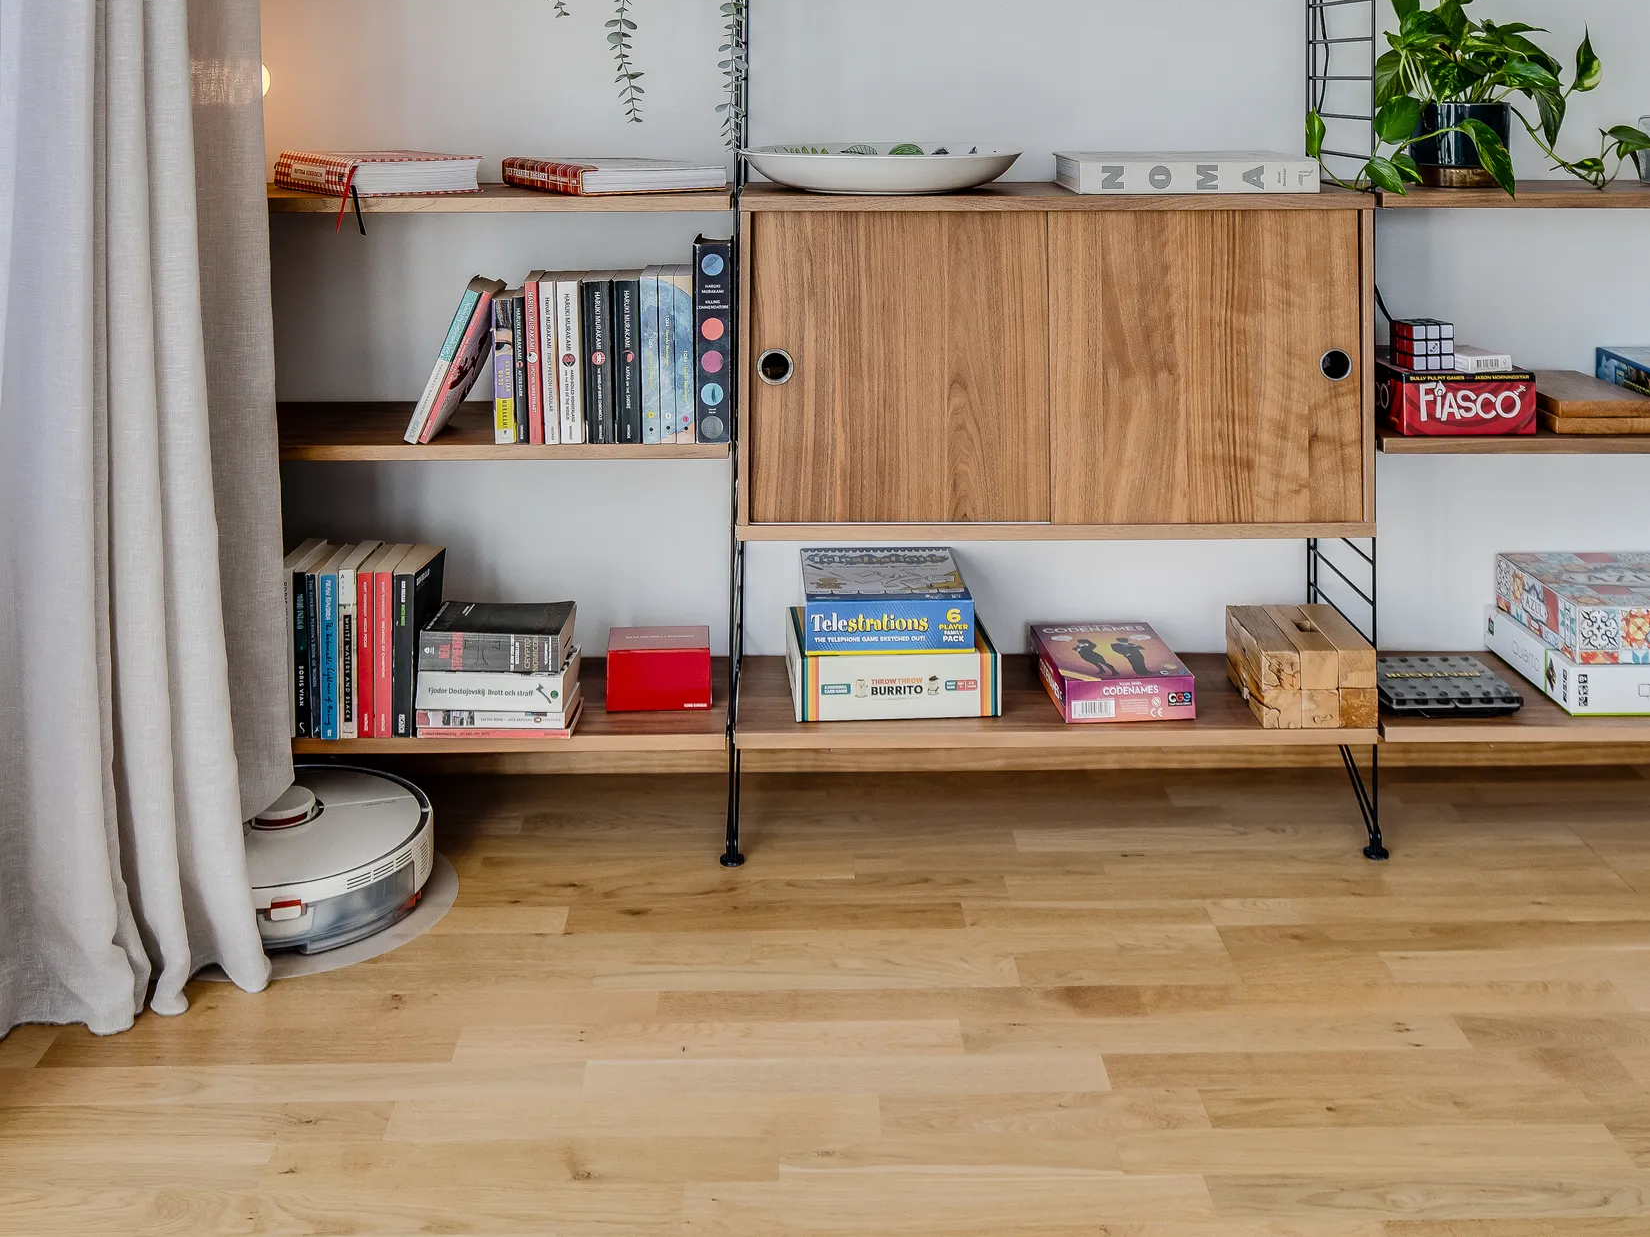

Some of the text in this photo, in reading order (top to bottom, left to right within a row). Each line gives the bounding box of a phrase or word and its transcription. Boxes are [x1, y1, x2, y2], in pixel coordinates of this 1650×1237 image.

[1102, 164, 1264, 190] NOMA
[1526, 595, 1543, 618] AZUL
[946, 608, 961, 622] 6
[810, 612, 929, 632] Telestrations
[1042, 626, 1145, 634] CODENAMES
[449, 688, 485, 696] Dostojevskij
[871, 685, 923, 696] BURRITO
[1102, 684, 1159, 696] CODENAMES
